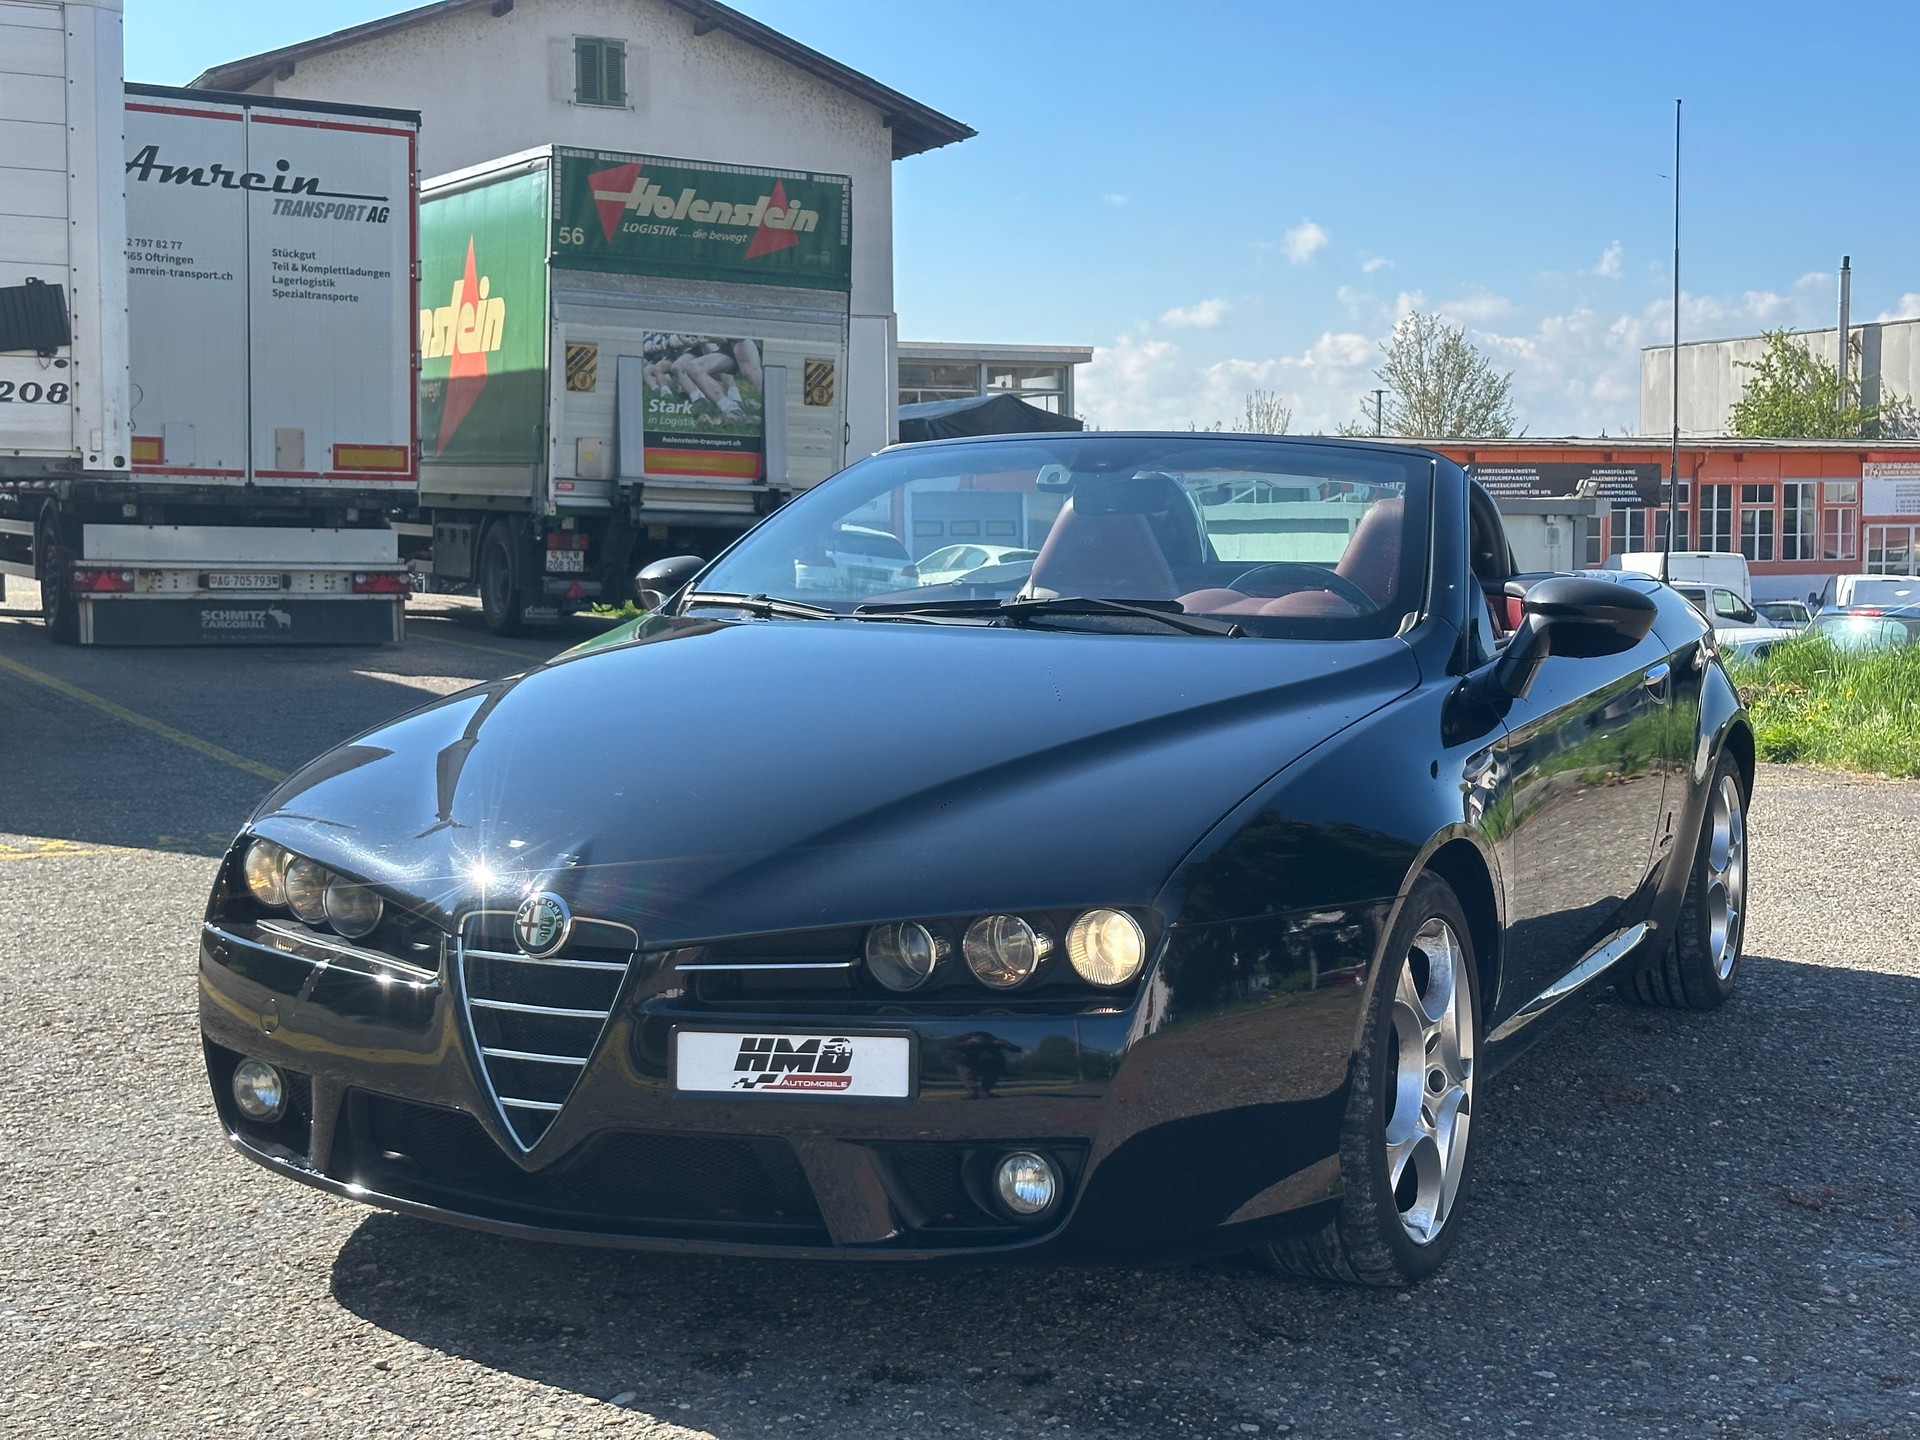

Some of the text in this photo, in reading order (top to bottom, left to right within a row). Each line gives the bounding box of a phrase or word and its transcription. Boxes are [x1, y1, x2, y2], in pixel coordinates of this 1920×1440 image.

[126, 145, 320, 195] Amrein
[272, 198, 390, 223] TRANSPORT AG
[594, 177, 819, 232] Holenstein
[558, 227, 585, 245] 56
[623, 223, 679, 236] LOGISTIK
[709, 230, 748, 244] bewegt
[135, 238, 153, 248] 797
[155, 240, 168, 249] 82
[170, 241, 183, 250] 77
[145, 252, 194, 265] Oftringen
[272, 248, 316, 261] Stückgut
[129, 266, 233, 281] amrein-transport.ch
[272, 262, 390, 279] Teil & Komplettladungen
[272, 275, 336, 289] Lagerlogistik
[272, 289, 359, 302] Spezialtransporte
[648, 399, 693, 414] Stark
[648, 416, 696, 427] in Logistik
[662, 436, 742, 446] holenstein-transport.ch
[200, 610, 266, 621] SCHMITZ
[201, 620, 266, 629] CARGOBULL
[540, 898, 563, 928] ROMEO
